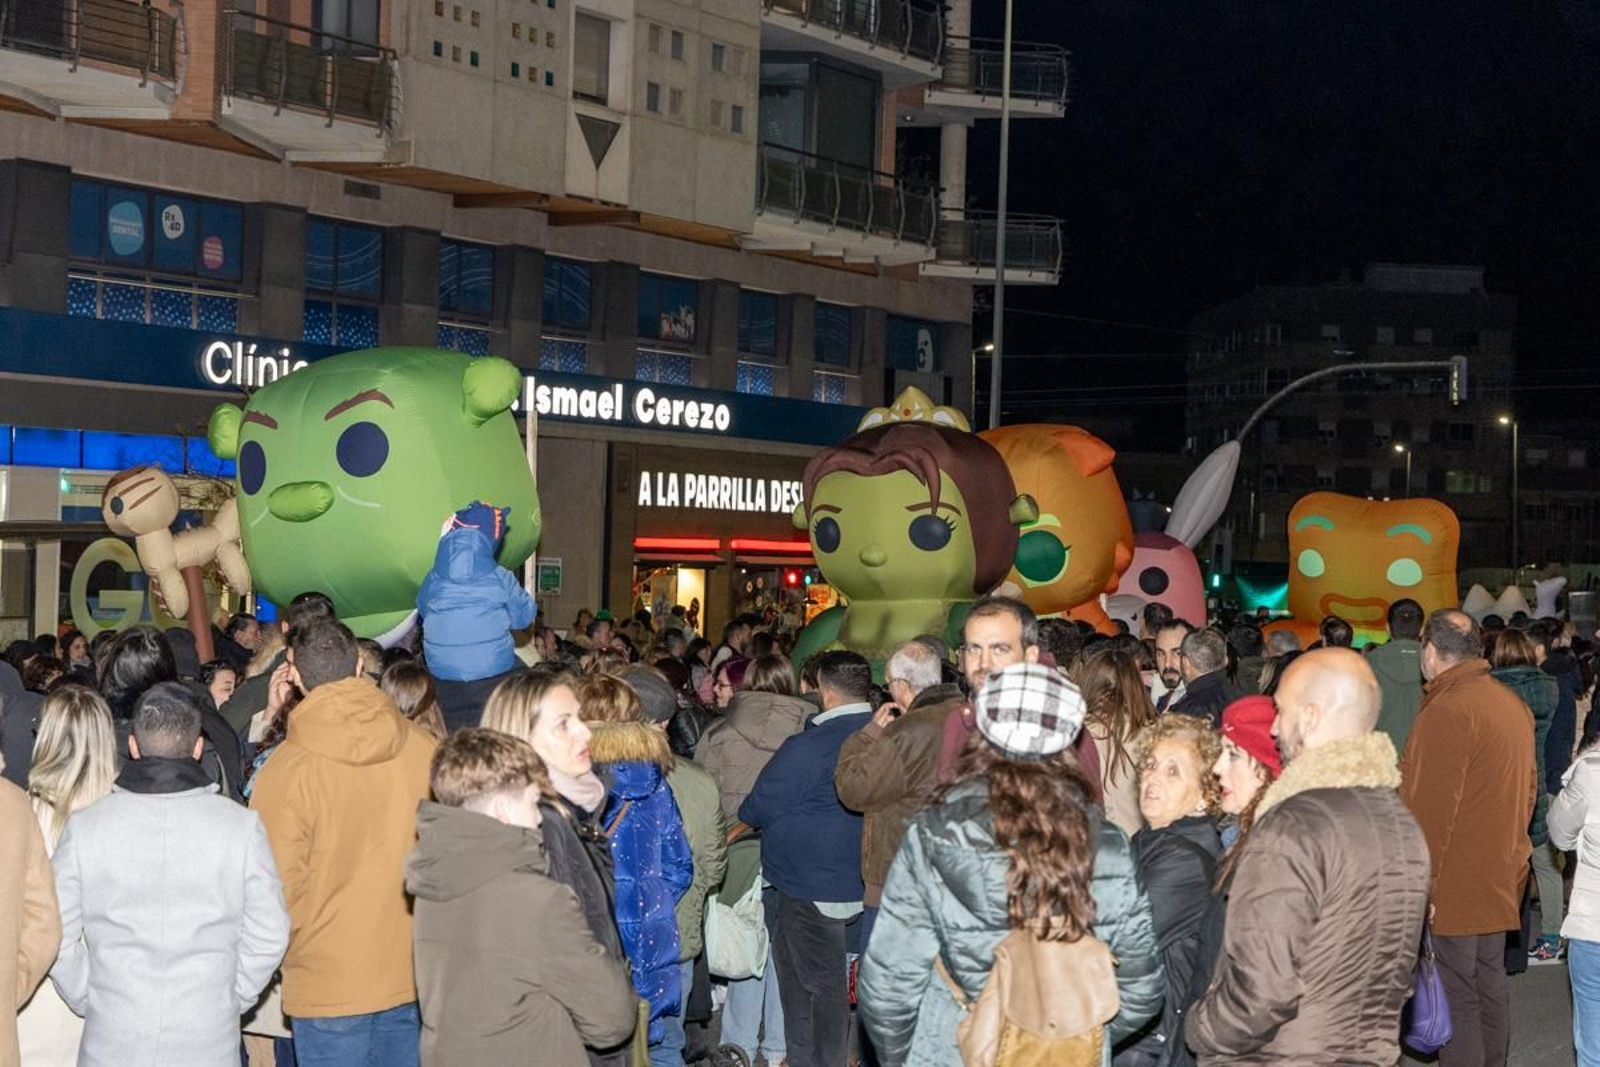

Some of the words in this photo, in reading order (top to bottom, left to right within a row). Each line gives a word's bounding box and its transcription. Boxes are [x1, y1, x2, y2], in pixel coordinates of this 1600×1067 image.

[525, 376, 624, 420] Ismael
[634, 388, 731, 431] Cerezo
[638, 471, 652, 506] A
[657, 472, 680, 507] LA
[684, 473, 766, 512] PARRILLA
[770, 480, 804, 514] DES
